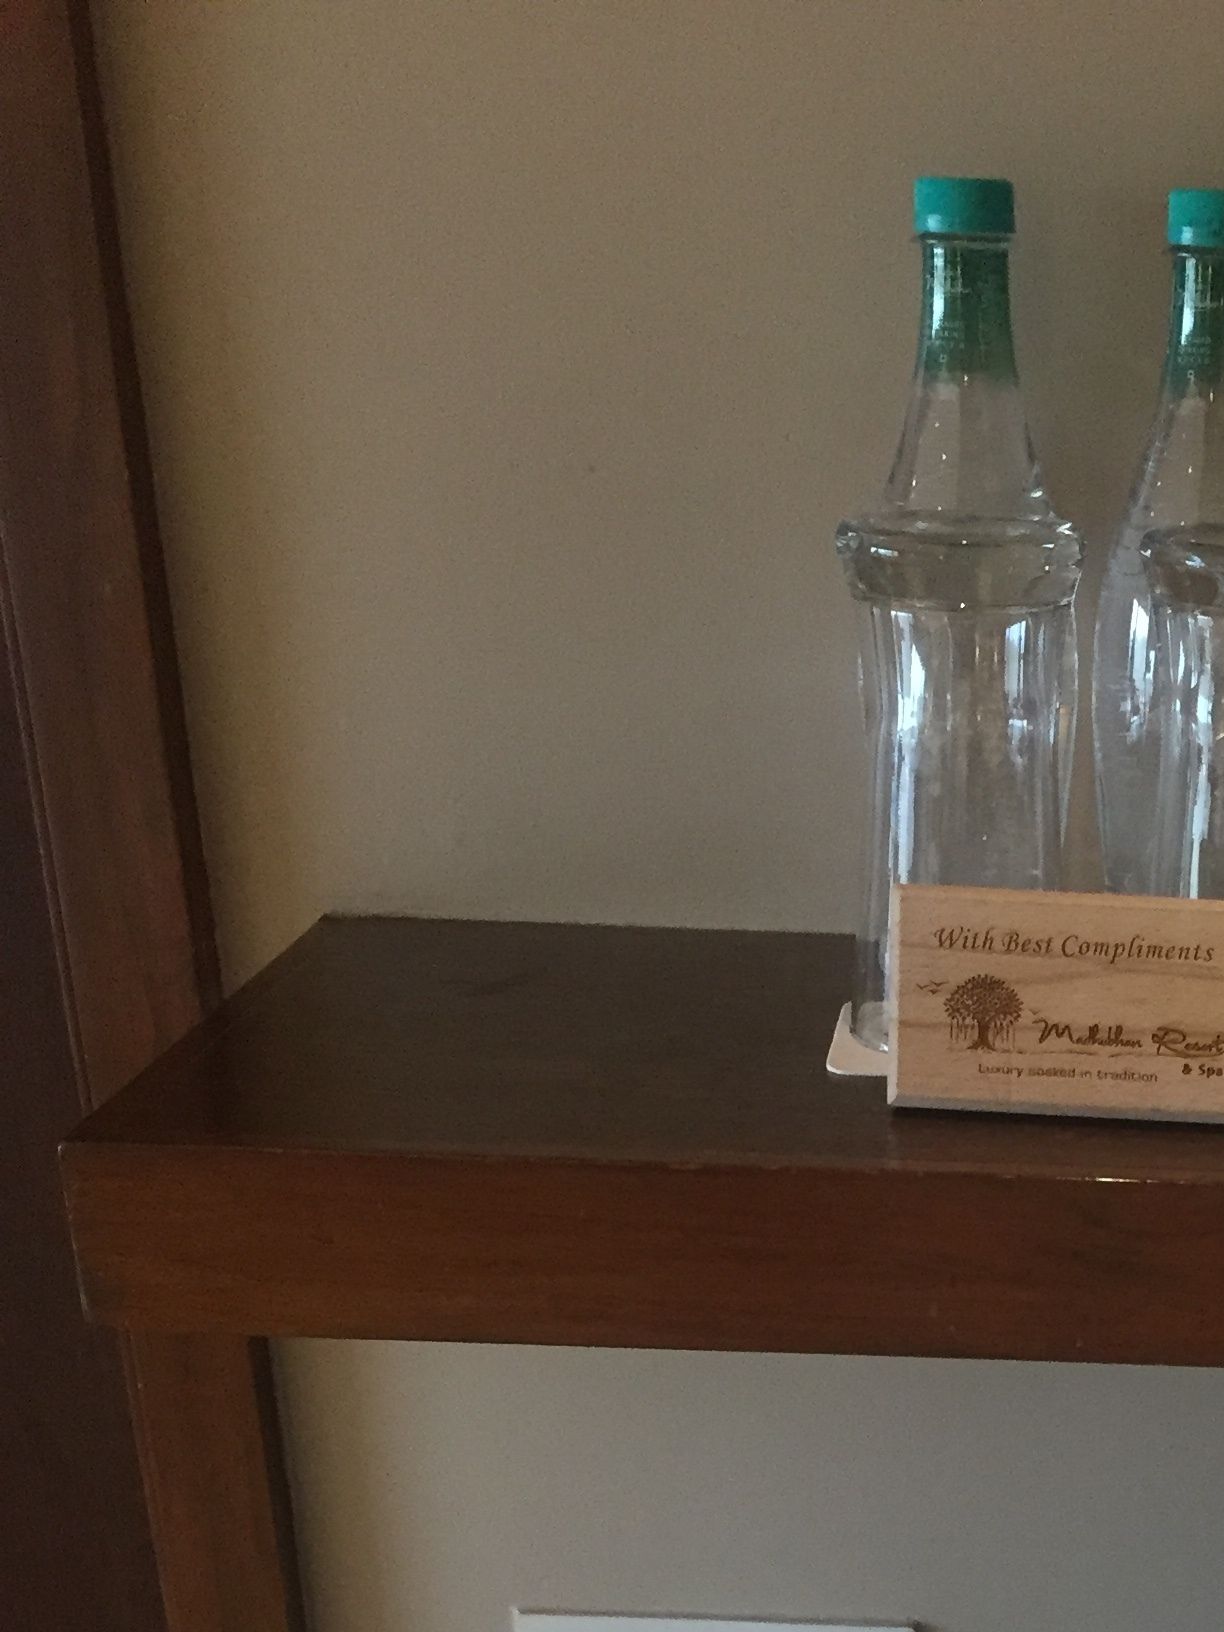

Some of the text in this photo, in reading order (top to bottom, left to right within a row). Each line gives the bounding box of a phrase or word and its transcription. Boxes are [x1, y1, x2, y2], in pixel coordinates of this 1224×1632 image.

[934, 926, 1215, 964] With Best Compliments
[977, 1063, 1024, 1078] Luxury
[1028, 1066, 1076, 1078] soaked
[1097, 1069, 1158, 1083] tradition
[1182, 1063, 1223, 1079] & Spa
